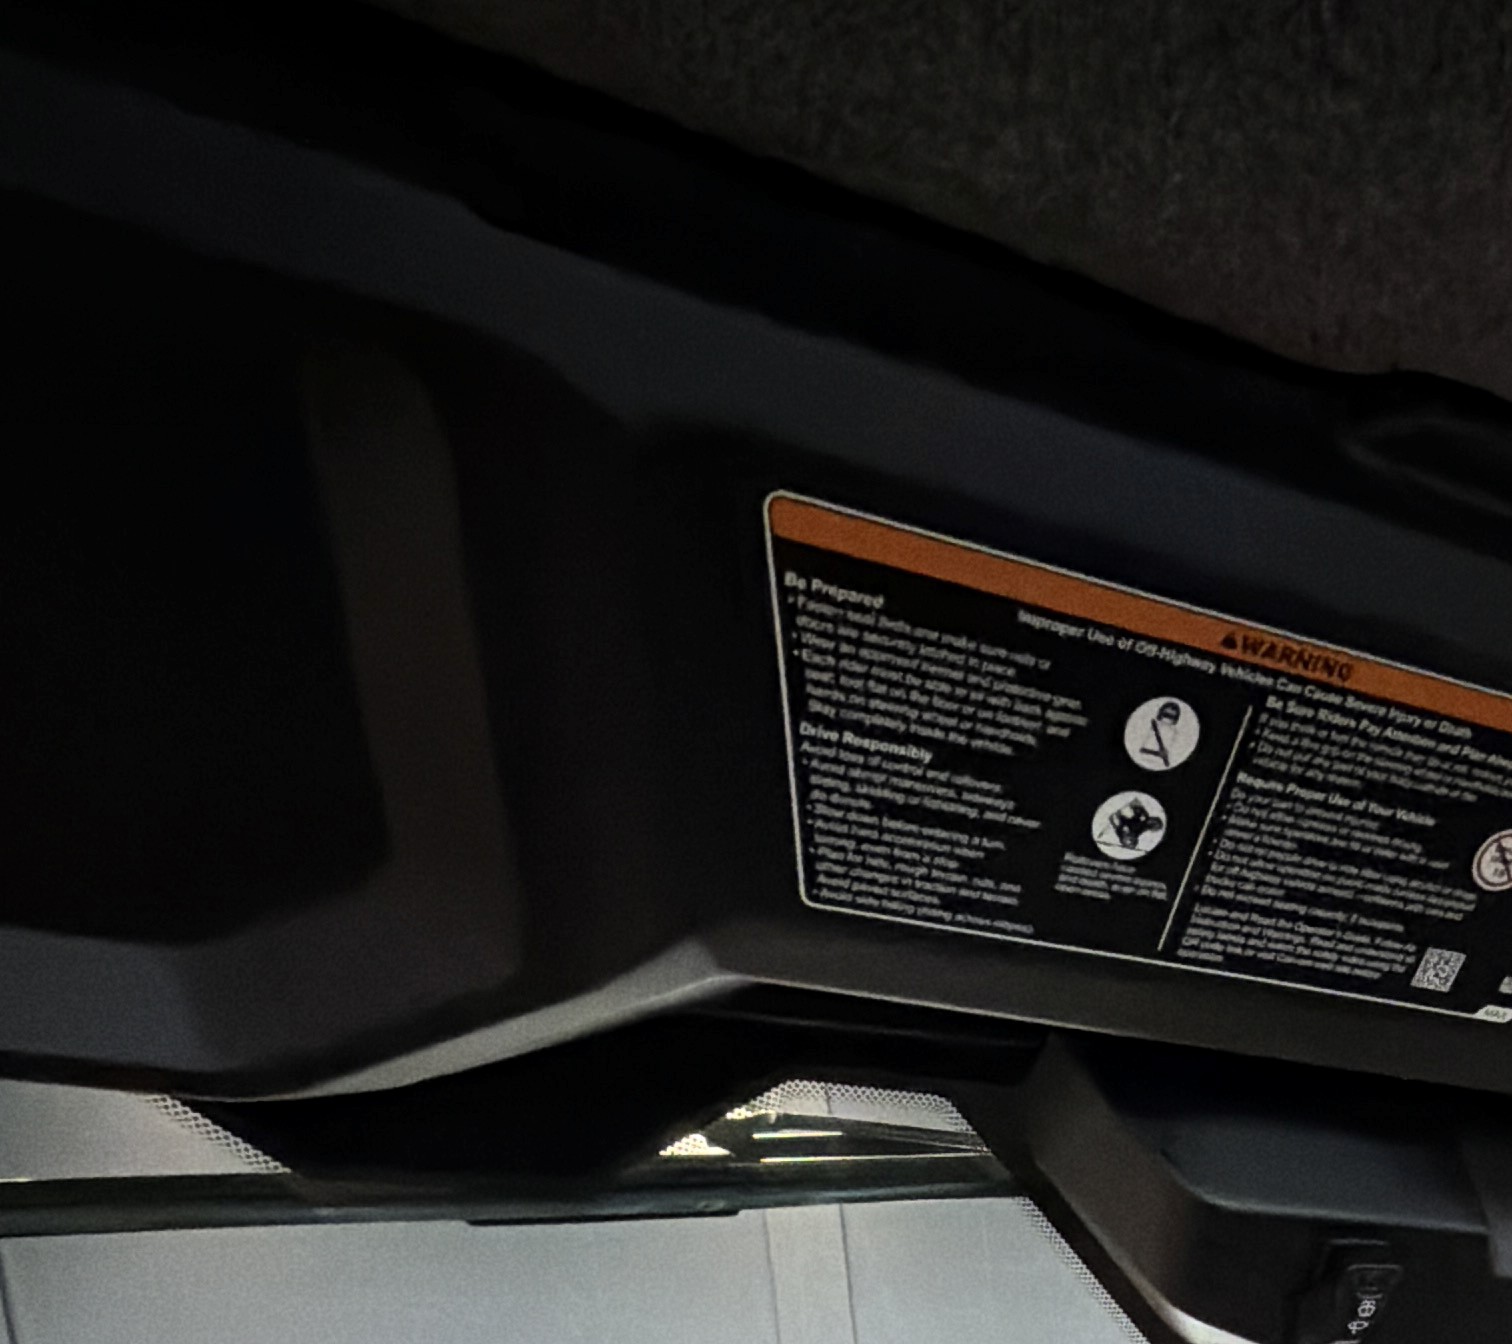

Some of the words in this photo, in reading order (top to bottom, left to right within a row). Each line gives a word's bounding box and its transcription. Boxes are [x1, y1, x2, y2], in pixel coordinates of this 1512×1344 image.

[783, 572, 805, 590] Be
[810, 578, 884, 611] Prepared
[1018, 611, 1085, 639] Improper
[1087, 629, 1117, 647] Use
[1118, 637, 1134, 652] of
[1218, 664, 1275, 688] Vehicles
[1275, 679, 1303, 695] Can
[1303, 686, 1345, 706] Cause
[1345, 697, 1389, 717] Severe
[1388, 709, 1422, 726] Injury
[1436, 721, 1474, 739] Death
[1240, 635, 1354, 682] WARNING
[798, 723, 838, 741] Drive
[842, 731, 933, 764] Responsibly
[1265, 695, 1285, 711] Be
[1285, 701, 1316, 719] Sure
[1316, 709, 1358, 729] Riders
[1358, 720, 1383, 735] Pay
[1381, 726, 1438, 749] Attention
[1436, 740, 1461, 755] and
[1460, 746, 1488, 761] Plan
[1235, 772, 1285, 794] Require
[1284, 784, 1327, 803] Proper
[1326, 794, 1352, 809] Use
[1351, 799, 1367, 812] of
[1366, 803, 1395, 818] Your
[1394, 809, 1437, 828] Vehicle
